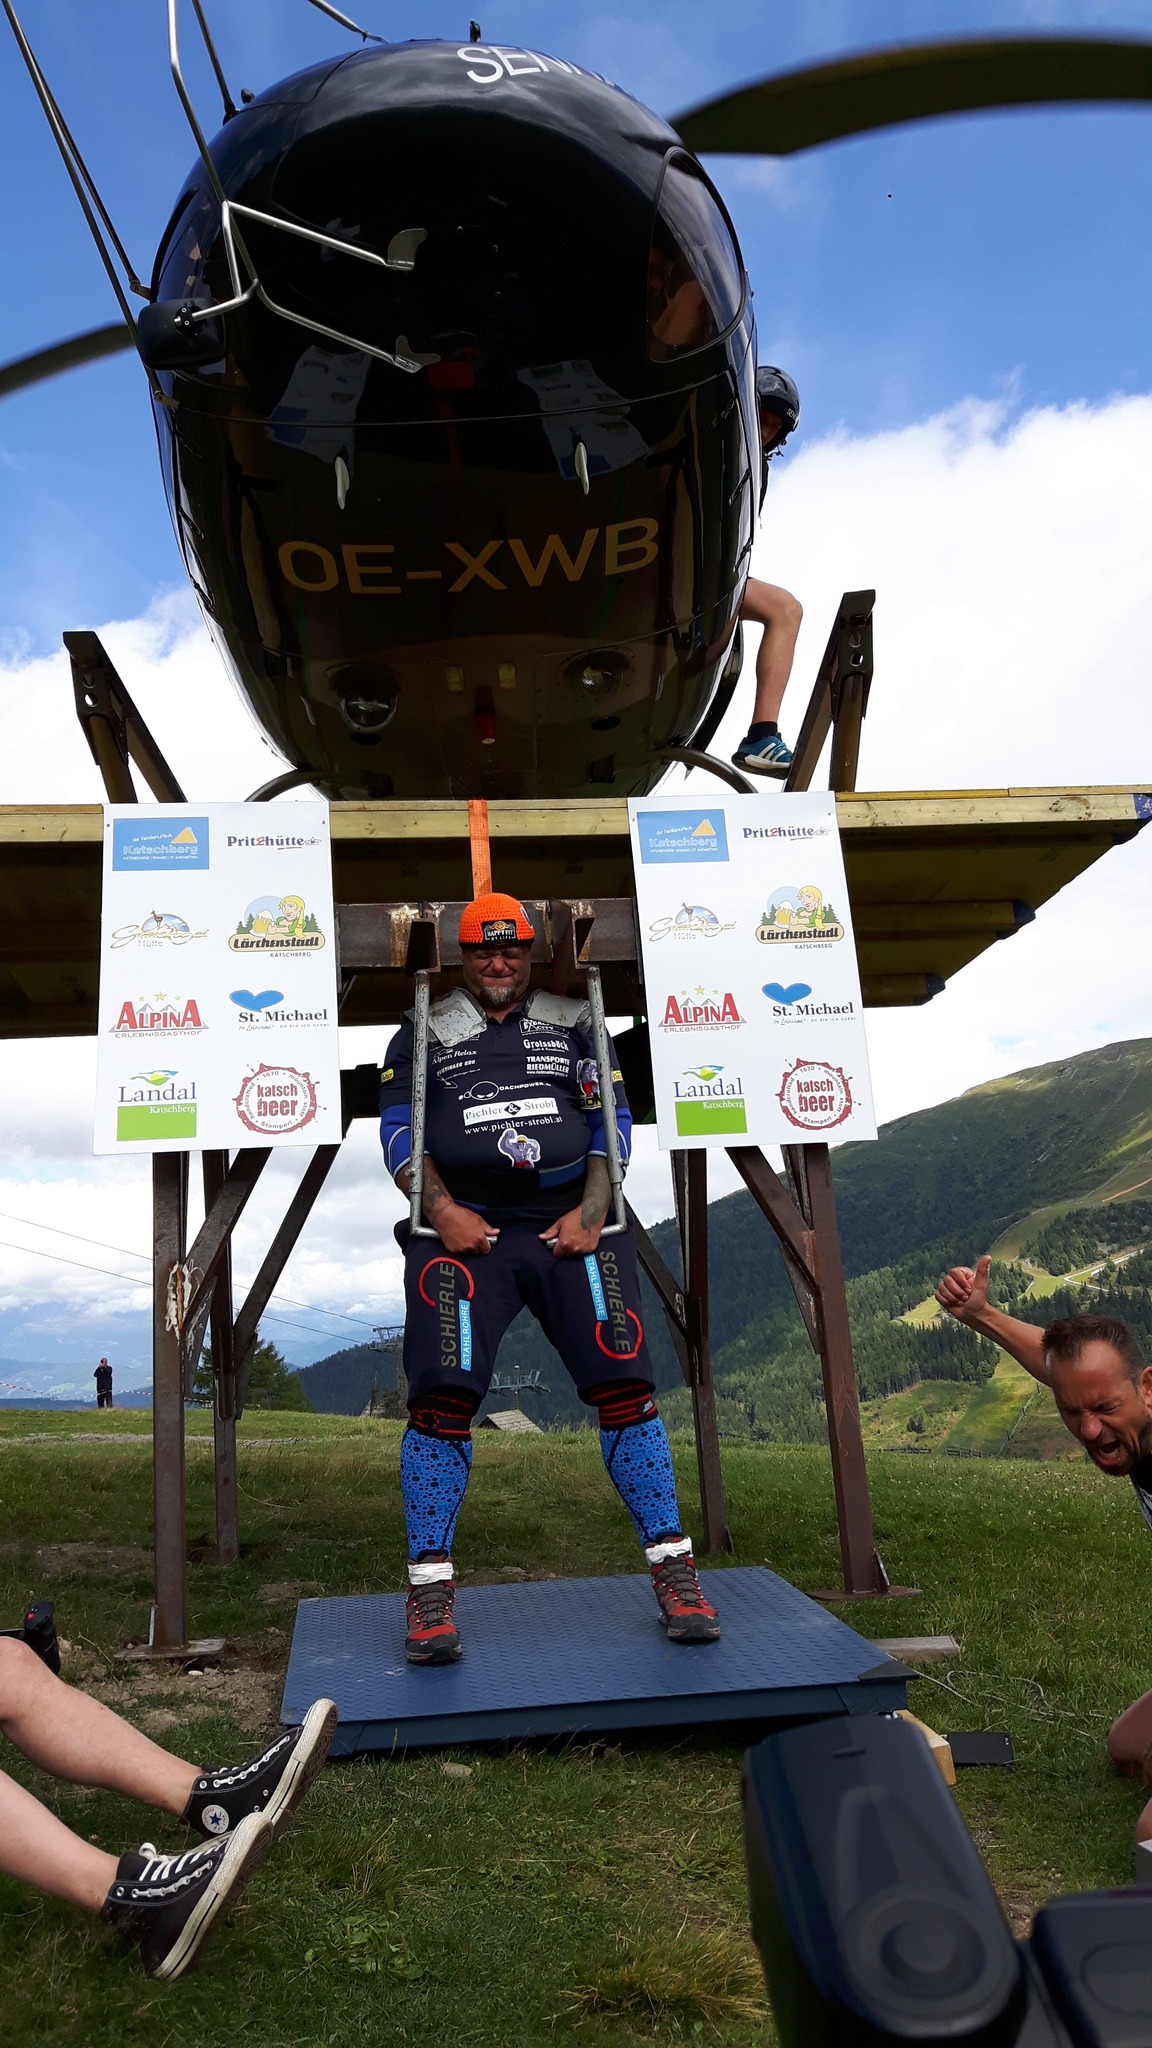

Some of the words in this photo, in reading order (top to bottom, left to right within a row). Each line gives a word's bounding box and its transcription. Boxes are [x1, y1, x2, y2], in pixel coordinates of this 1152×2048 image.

[278, 517, 660, 595] OE-XWB
[123, 844, 198, 855] Katschberg
[648, 837, 718, 848] Katschberg
[760, 927, 839, 940] Lärchenstadl
[233, 936, 319, 949] Lärchenstadl
[238, 1011, 260, 1023] St.
[265, 1008, 328, 1022] Michael
[772, 1005, 792, 1017] St.
[795, 1001, 855, 1016] Michael
[115, 1030, 202, 1038] ERLEBNISGASTHOF
[664, 1025, 741, 1033] ERLEBNISGASTHOF
[432, 1053, 453, 1065] Alpen
[454, 1050, 478, 1058] Relax
[526, 1055, 570, 1066] TRANSPORTE
[262, 1070, 280, 1078] 1670
[526, 1062, 570, 1074] RIEDMÜLLER
[288, 1074, 309, 1099] mountain
[672, 1077, 744, 1098] Landal
[796, 1078, 834, 1094] katsch
[823, 1069, 844, 1095] mountain
[118, 1081, 198, 1103] Landal
[257, 1083, 298, 1098] katsch
[149, 1105, 196, 1114] Katschberg
[257, 1098, 298, 1117] beer
[465, 1106, 503, 1120] Pichler
[507, 1103, 519, 1113] &
[523, 1100, 555, 1111] Strobl
[703, 1100, 744, 1109] Katschberg
[798, 1094, 835, 1113] beer
[260, 1120, 293, 1129] Stamperl
[464, 1115, 564, 1135] www.pichler-strobl.at
[803, 1116, 832, 1125] Stamperl
[600, 1250, 632, 1353] SCHIERLE
[439, 1262, 457, 1368] SCHIERLE
[460, 1303, 470, 1365] STAHLROHRE
